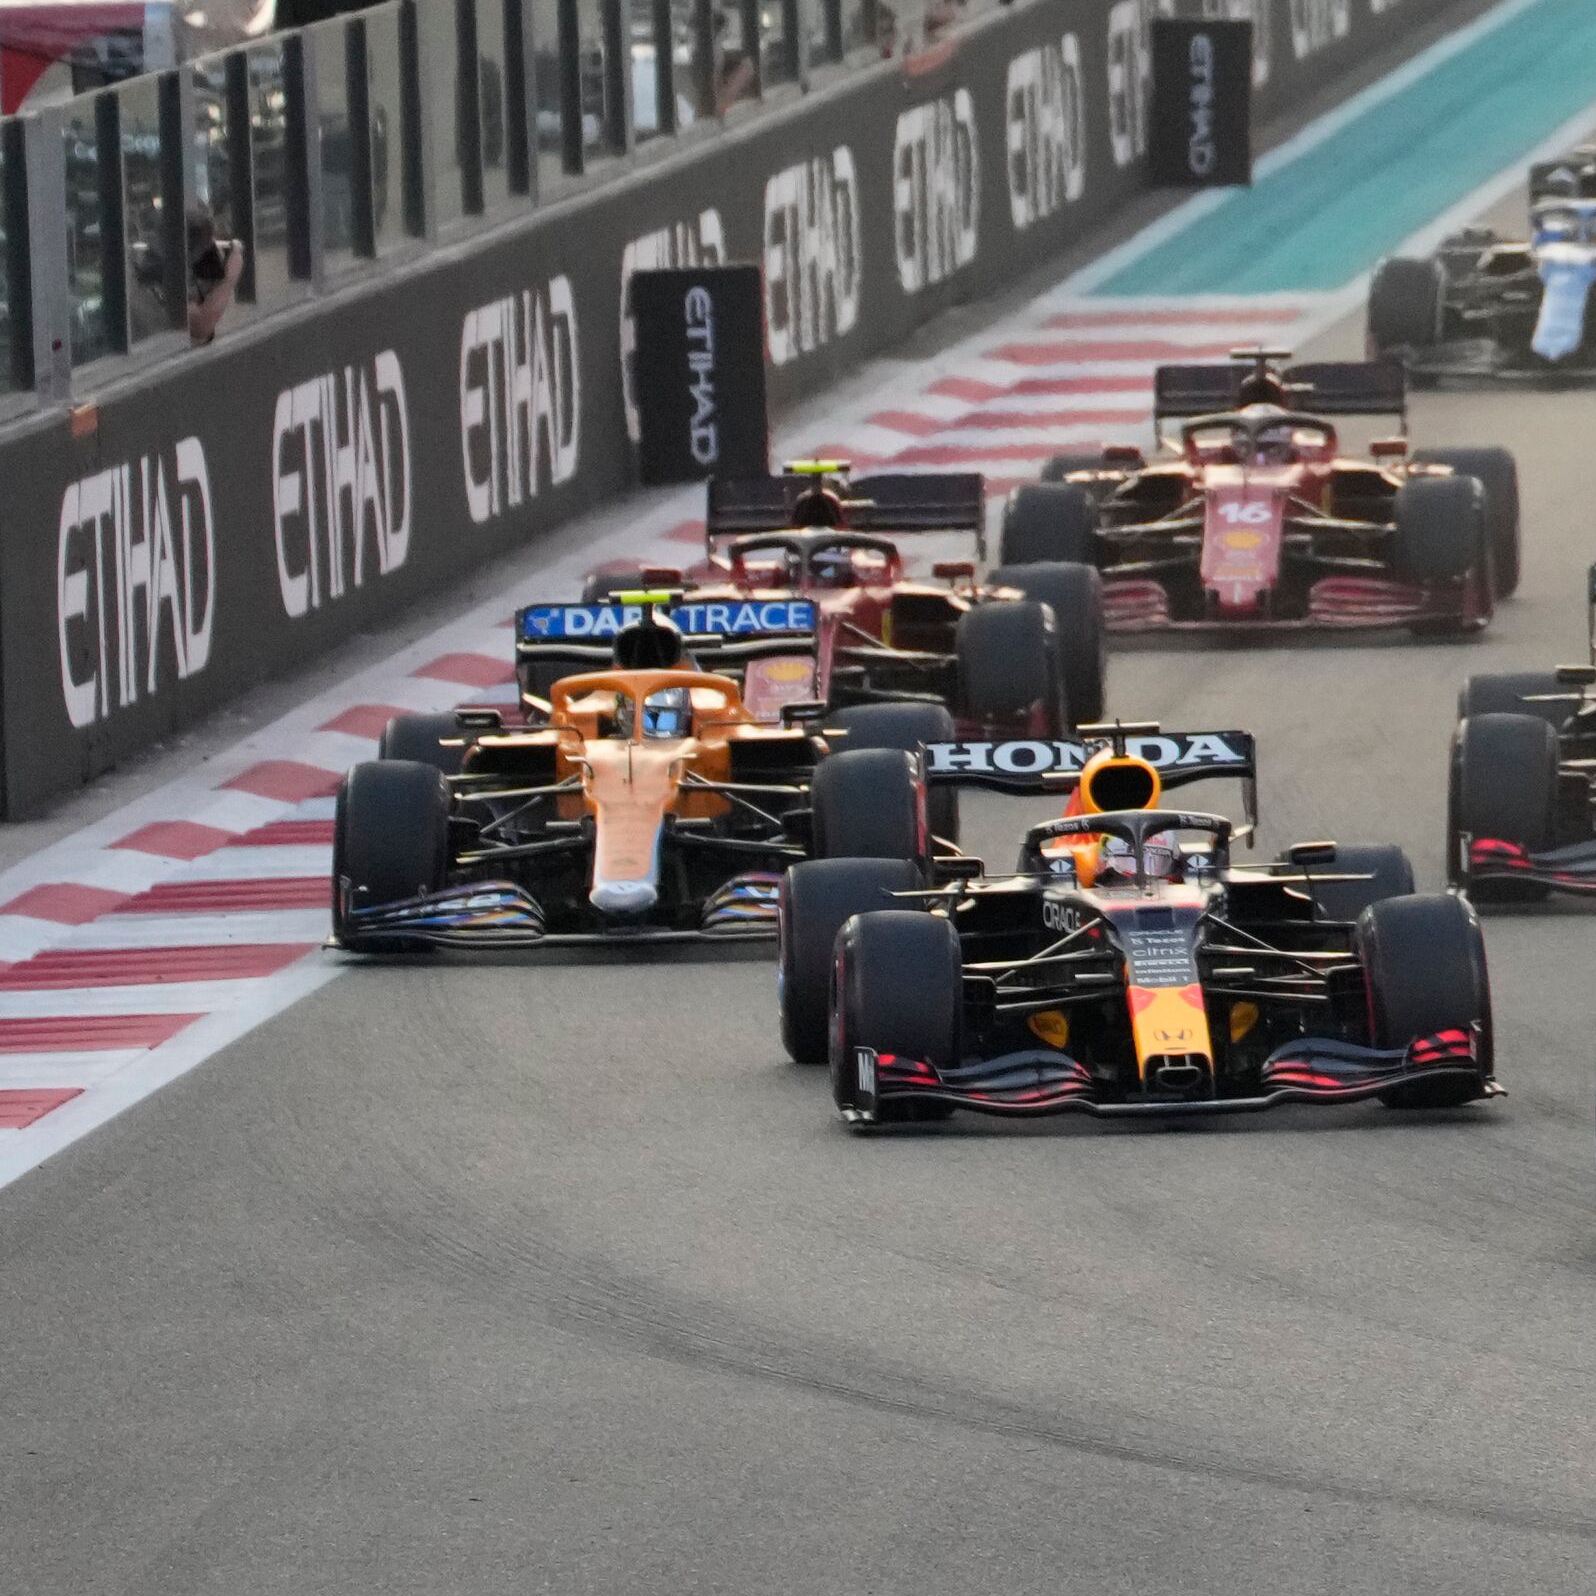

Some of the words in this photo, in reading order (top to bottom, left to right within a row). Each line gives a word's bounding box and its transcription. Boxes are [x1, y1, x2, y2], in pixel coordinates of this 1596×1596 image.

[273, 349, 412, 617] ETIHAD
[460, 274, 580, 524] ETIHAD
[684, 285, 718, 466] ETIHAD
[57, 436, 214, 728] ETIHAD
[1219, 502, 1272, 525] 16
[1132, 946, 1189, 957] citrix
